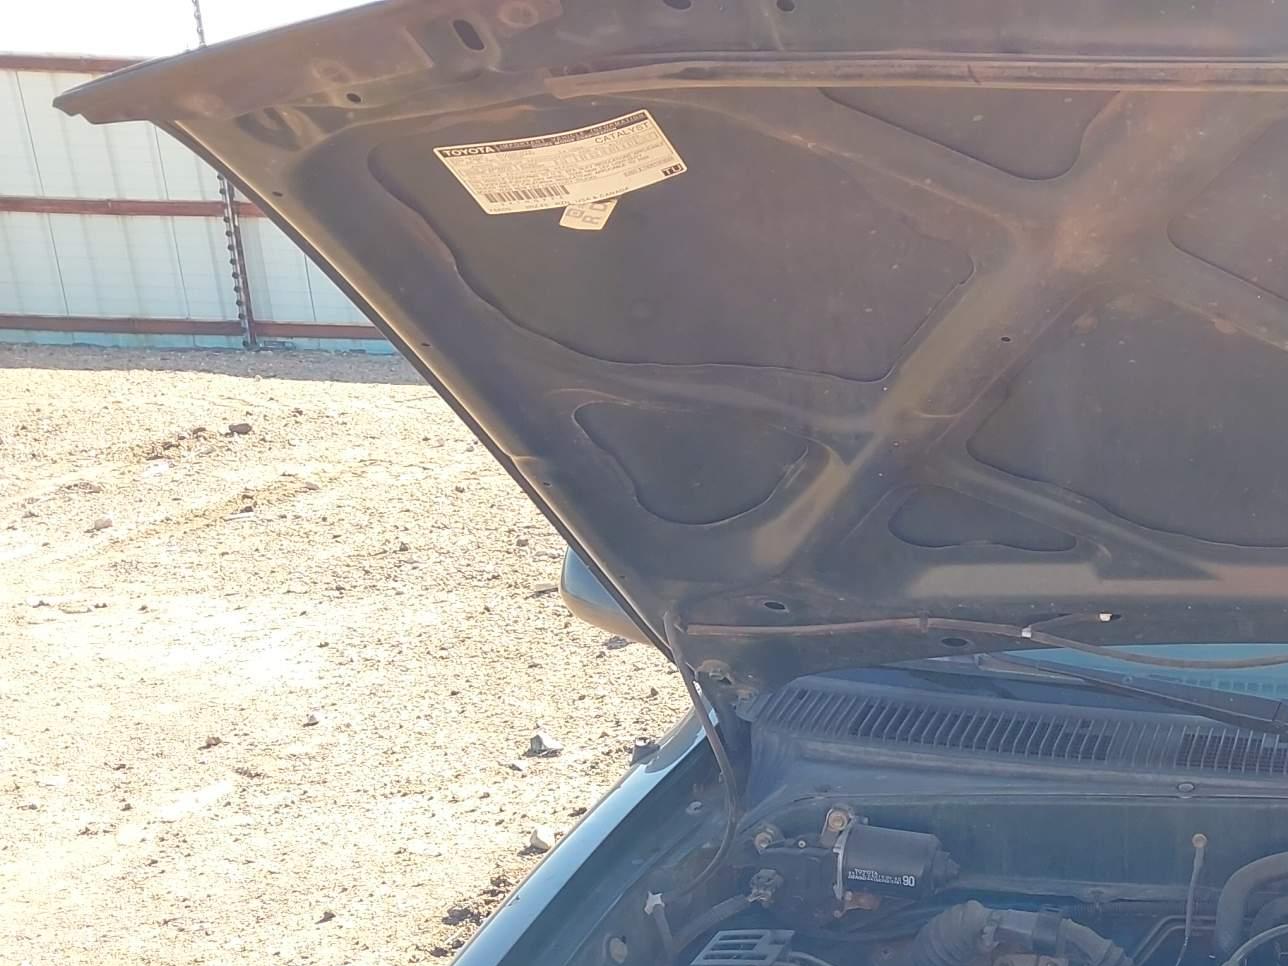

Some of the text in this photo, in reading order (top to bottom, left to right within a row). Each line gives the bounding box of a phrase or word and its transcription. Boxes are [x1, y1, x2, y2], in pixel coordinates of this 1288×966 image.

[594, 121, 651, 144] CATALYST
[442, 145, 495, 157] TOYOTA
[902, 875, 916, 887] 90
